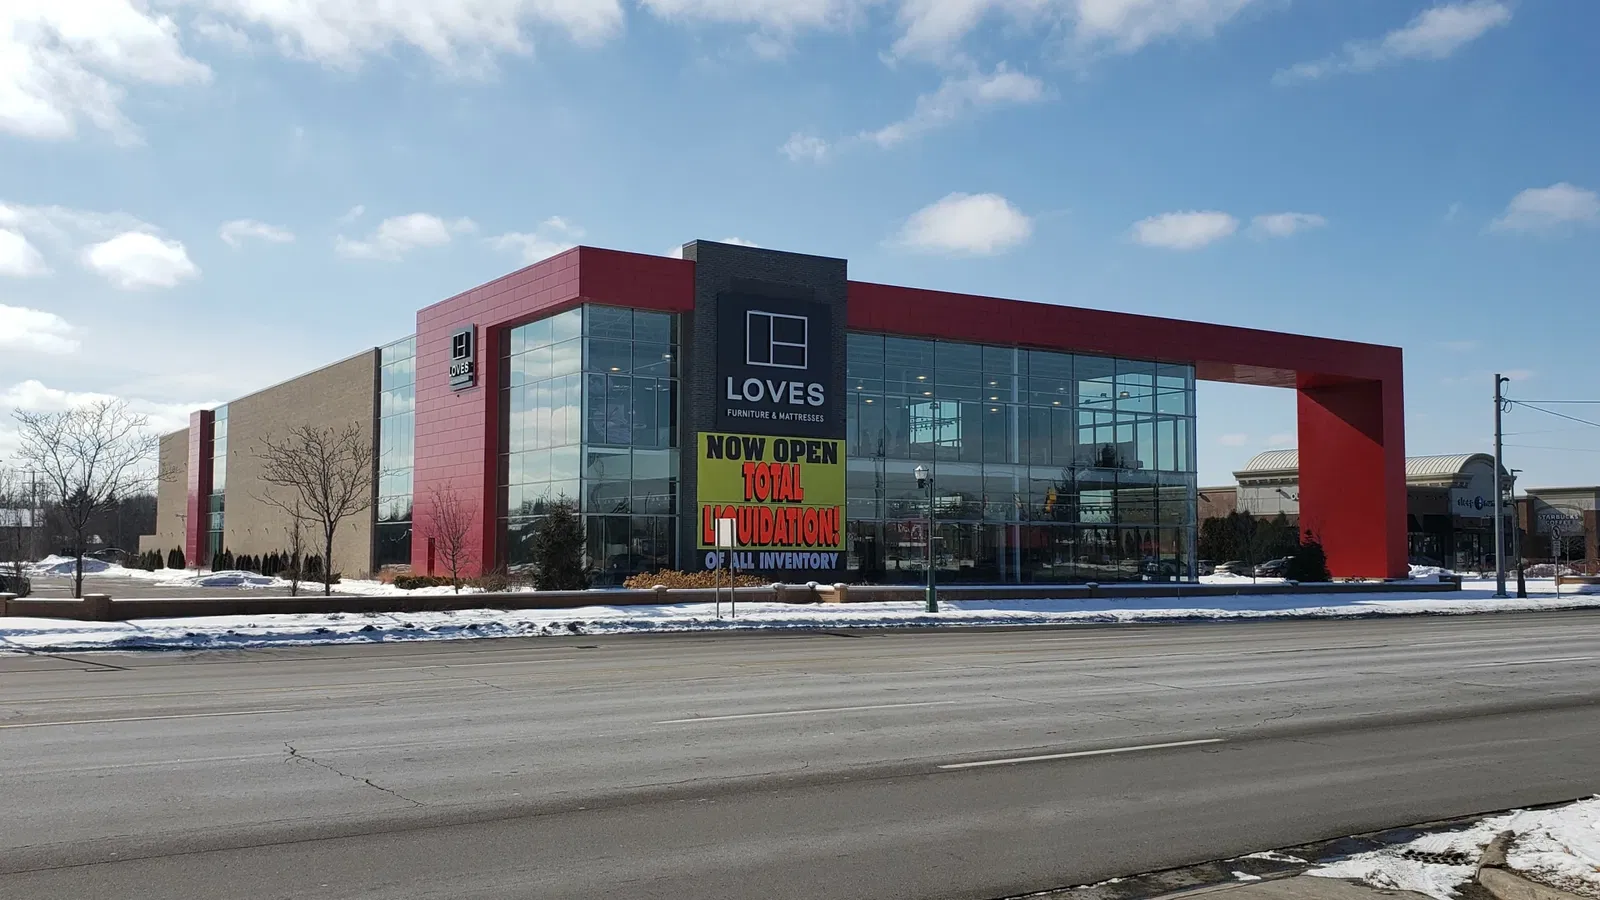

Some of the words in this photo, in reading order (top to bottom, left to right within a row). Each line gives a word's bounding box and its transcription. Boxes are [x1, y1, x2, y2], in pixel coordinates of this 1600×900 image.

[449, 361, 469, 377] LOVES
[727, 376, 825, 406] LOVES
[727, 409, 770, 419] FURNITURE
[771, 411, 777, 419] &
[779, 412, 825, 422] MATTRESSES
[706, 435, 766, 461] NOW
[773, 438, 838, 465] OPEN
[742, 461, 804, 502] TOTAL
[705, 552, 724, 569] OF
[730, 552, 755, 569] ALL
[759, 552, 838, 569] INVENTORY
